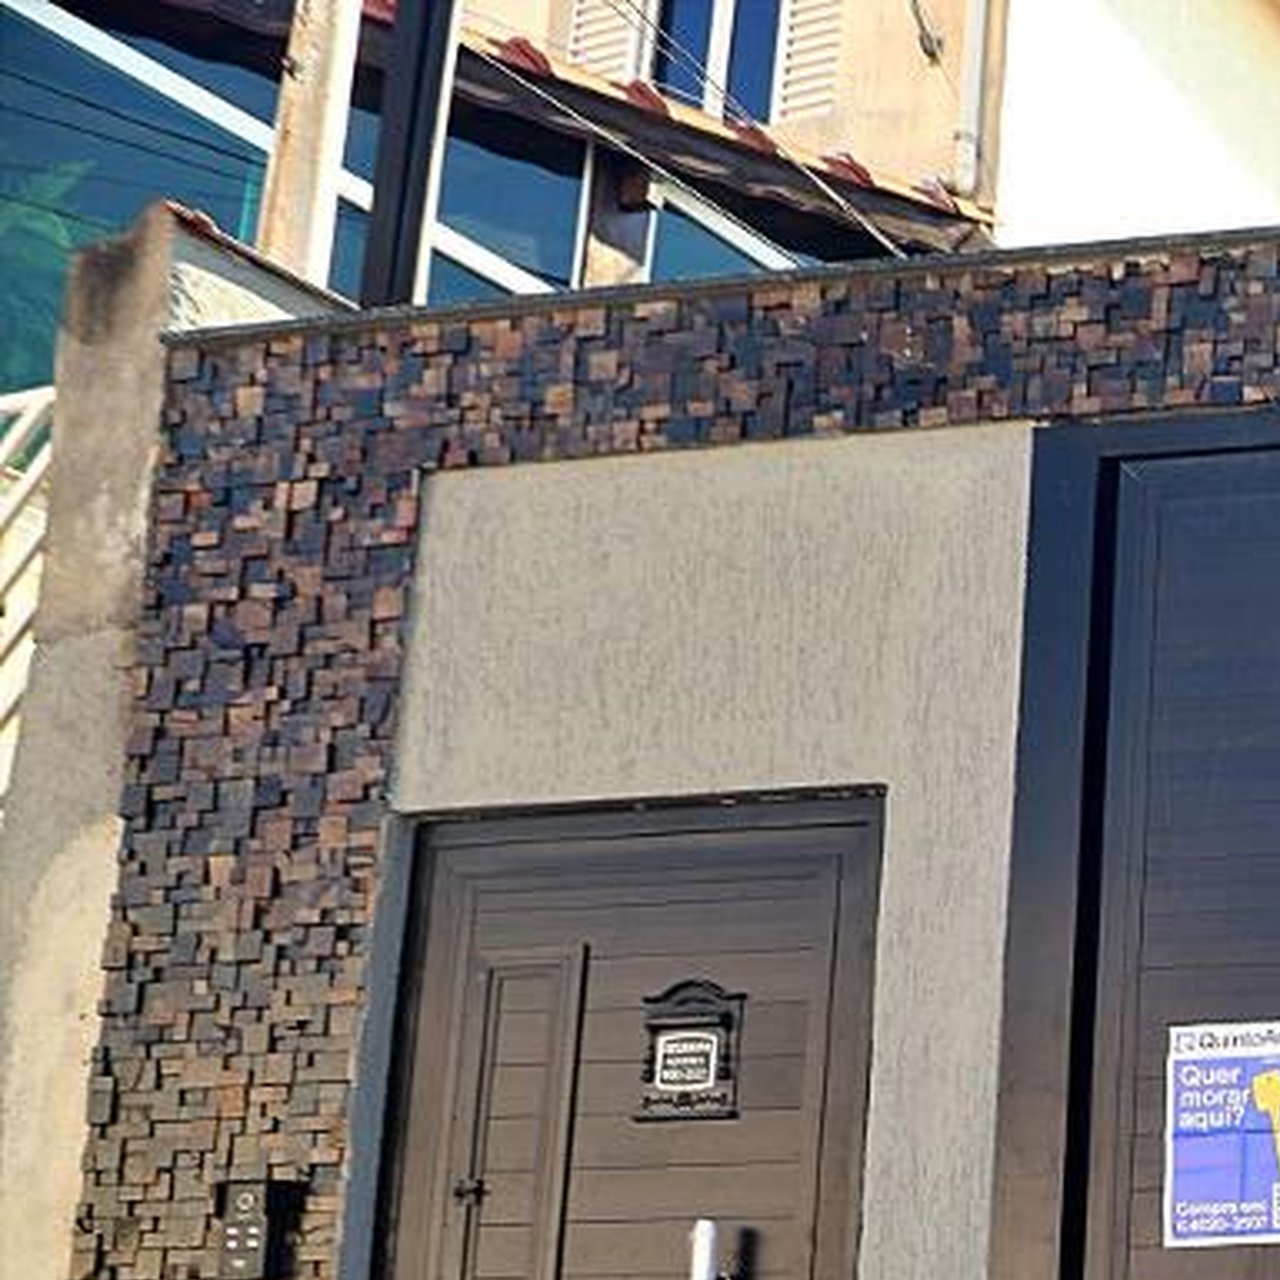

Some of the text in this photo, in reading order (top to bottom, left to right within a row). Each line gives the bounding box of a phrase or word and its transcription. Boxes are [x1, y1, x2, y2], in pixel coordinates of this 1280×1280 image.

[1179, 1065, 1241, 1087] Quer
[1180, 1088, 1250, 1108] morar
[1179, 1105, 1245, 1130] aqui?
